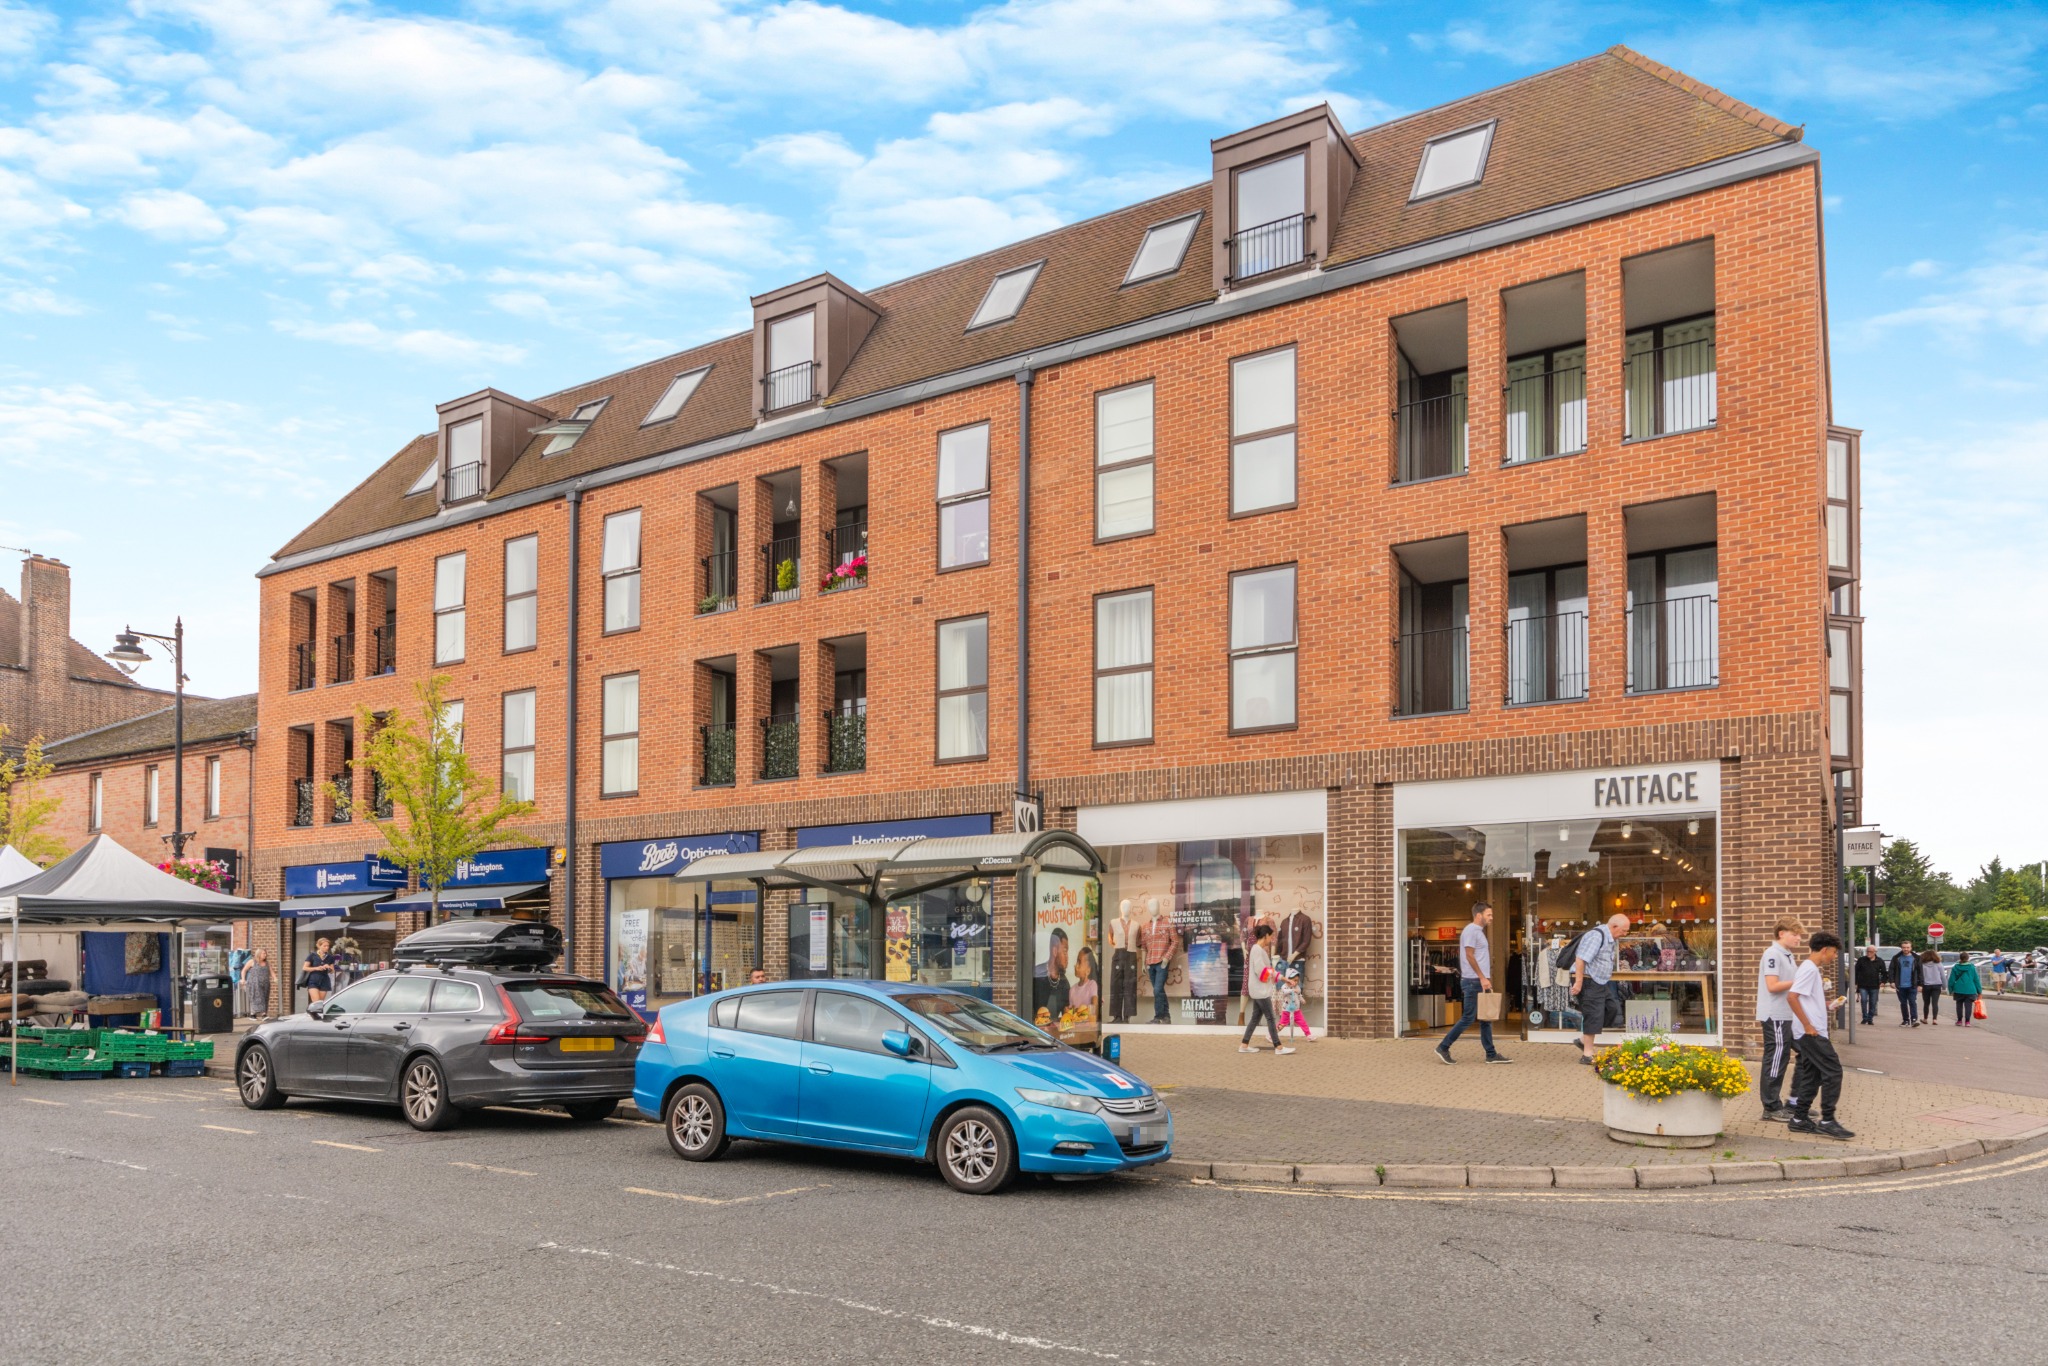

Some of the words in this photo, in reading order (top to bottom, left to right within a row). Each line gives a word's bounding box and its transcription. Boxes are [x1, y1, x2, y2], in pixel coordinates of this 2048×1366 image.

[1594, 771, 1699, 807] FATFACE
[1847, 842, 1874, 851] FATFACE
[638, 841, 679, 872] Boots
[680, 846, 730, 862] Opticians
[980, 856, 1013, 865] JCDecaux
[1042, 892, 1051, 904] WE
[1052, 893, 1060, 903] ARE
[1059, 885, 1077, 908] PRO
[954, 905, 981, 913] GREAT
[1037, 905, 1083, 928] MOUSTACHES
[625, 919, 640, 928] FREE
[886, 925, 906, 933] PRICE
[950, 922, 986, 939] see
[1768, 958, 1776, 969] 3
[1181, 998, 1215, 1011] FATFACE
[1195, 1011, 1205, 1019] FOR
[1109, 1075, 1128, 1086] L
